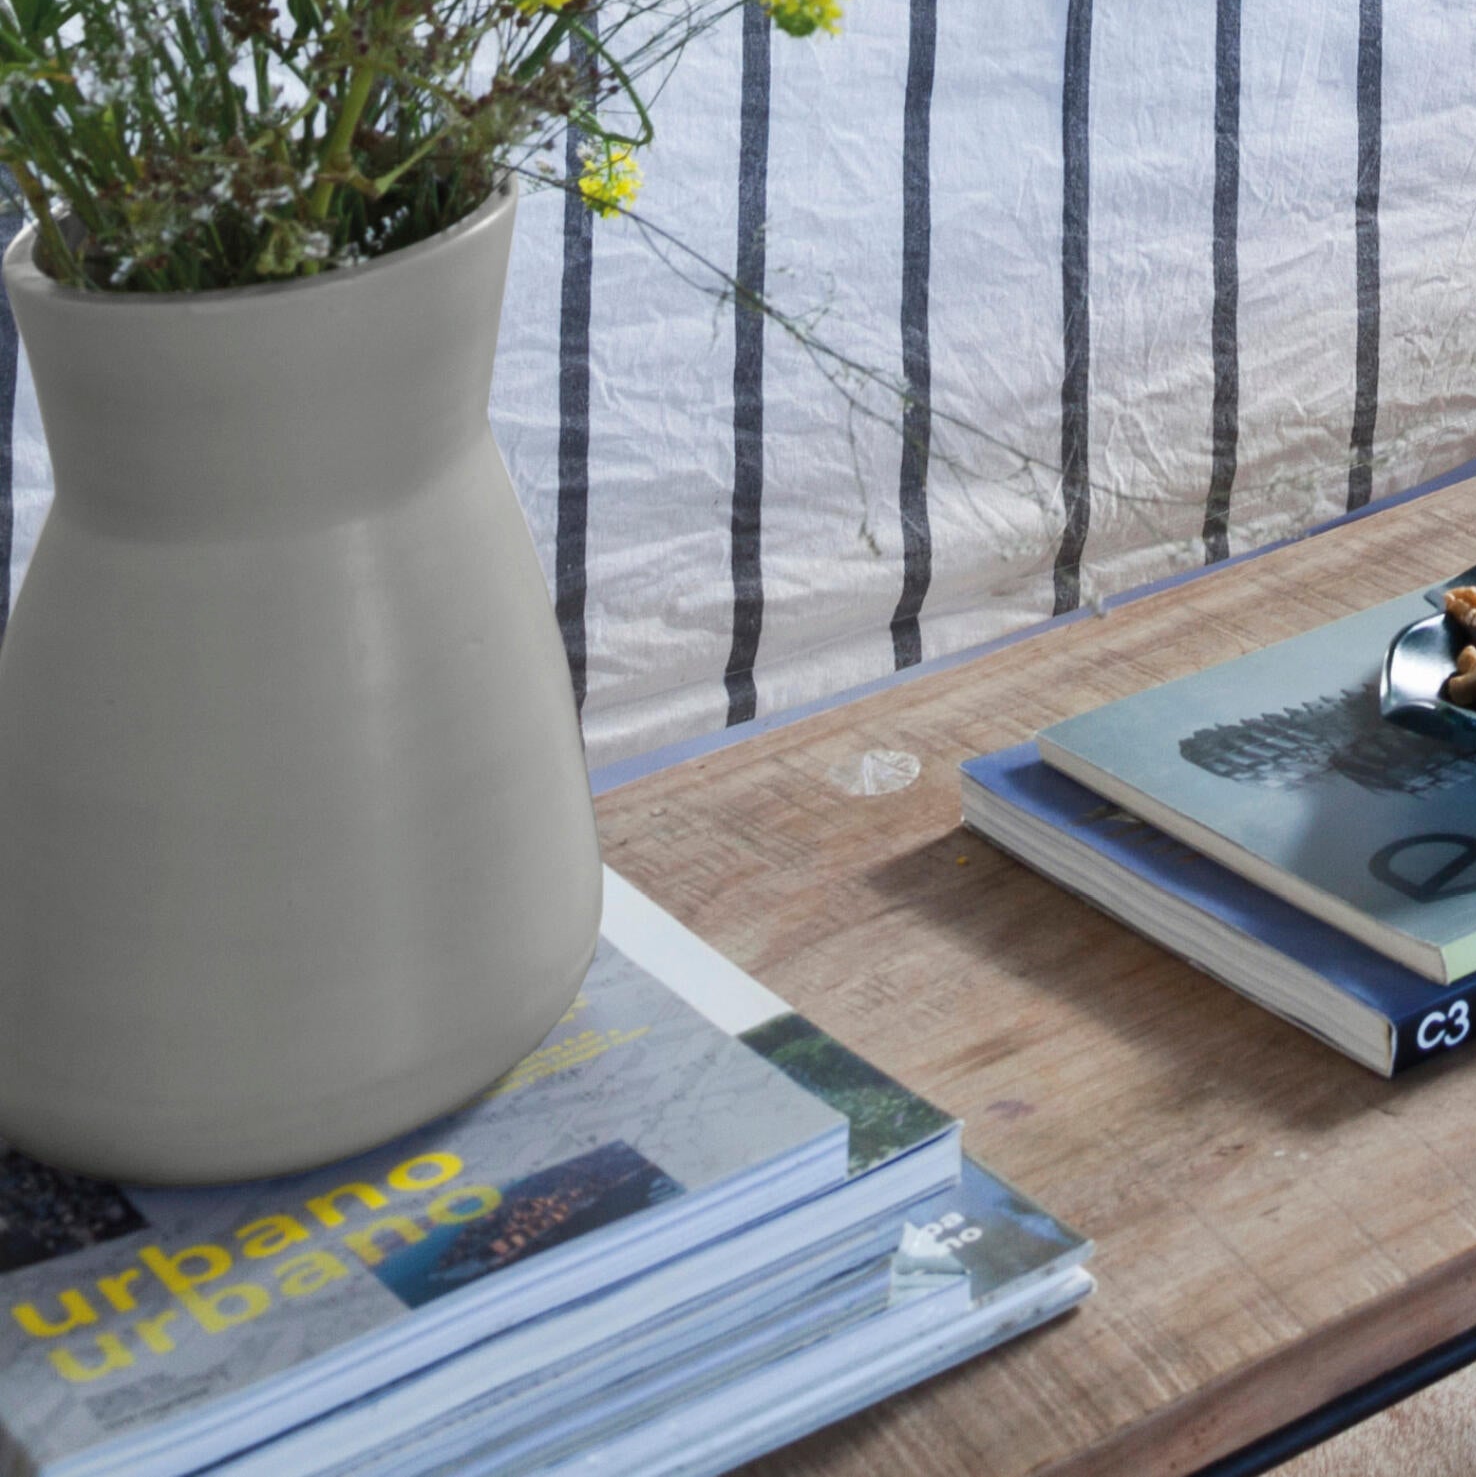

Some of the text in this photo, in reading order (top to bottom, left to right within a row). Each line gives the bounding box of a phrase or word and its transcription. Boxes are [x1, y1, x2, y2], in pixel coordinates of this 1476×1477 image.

[1416, 999, 1471, 1050] C3
[10, 1151, 464, 1339] urbano
[47, 1184, 502, 1383] urbano
